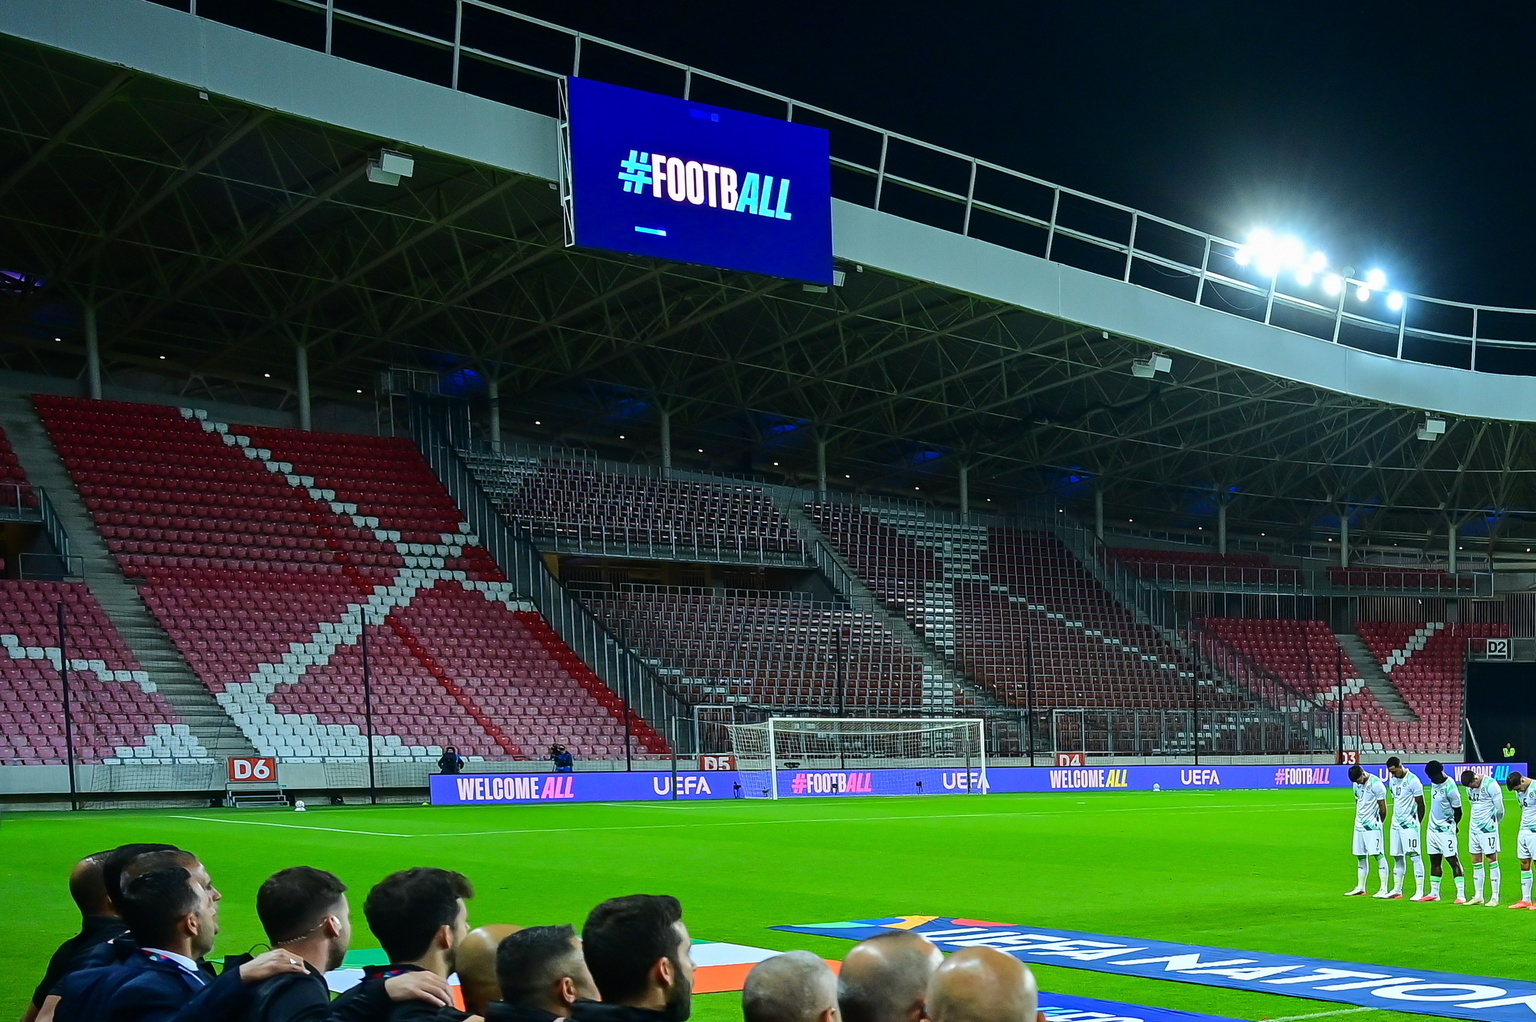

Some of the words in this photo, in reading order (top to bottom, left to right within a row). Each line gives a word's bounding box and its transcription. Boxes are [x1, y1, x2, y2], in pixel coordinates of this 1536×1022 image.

[618, 150, 792, 221] #FOOTBALL
[1488, 641, 1507, 653] D2
[704, 757, 730, 771] D5
[1060, 754, 1081, 767] D4
[234, 760, 270, 779] D6
[1180, 769, 1220, 785] UEFA
[1275, 768, 1330, 785] #FOOTBALL
[653, 776, 712, 796] UEFA
[791, 772, 872, 794] #FOOTBALL
[942, 772, 990, 790] UEFA
[1050, 769, 1105, 789] WELCOME
[1105, 768, 1128, 787] ALL
[457, 777, 540, 800] WELCOME
[541, 776, 574, 799] ALL
[1408, 839, 1418, 849] 10
[1447, 840, 1453, 849] 2
[1488, 837, 1496, 847] 17
[918, 927, 1128, 962] UEFA
